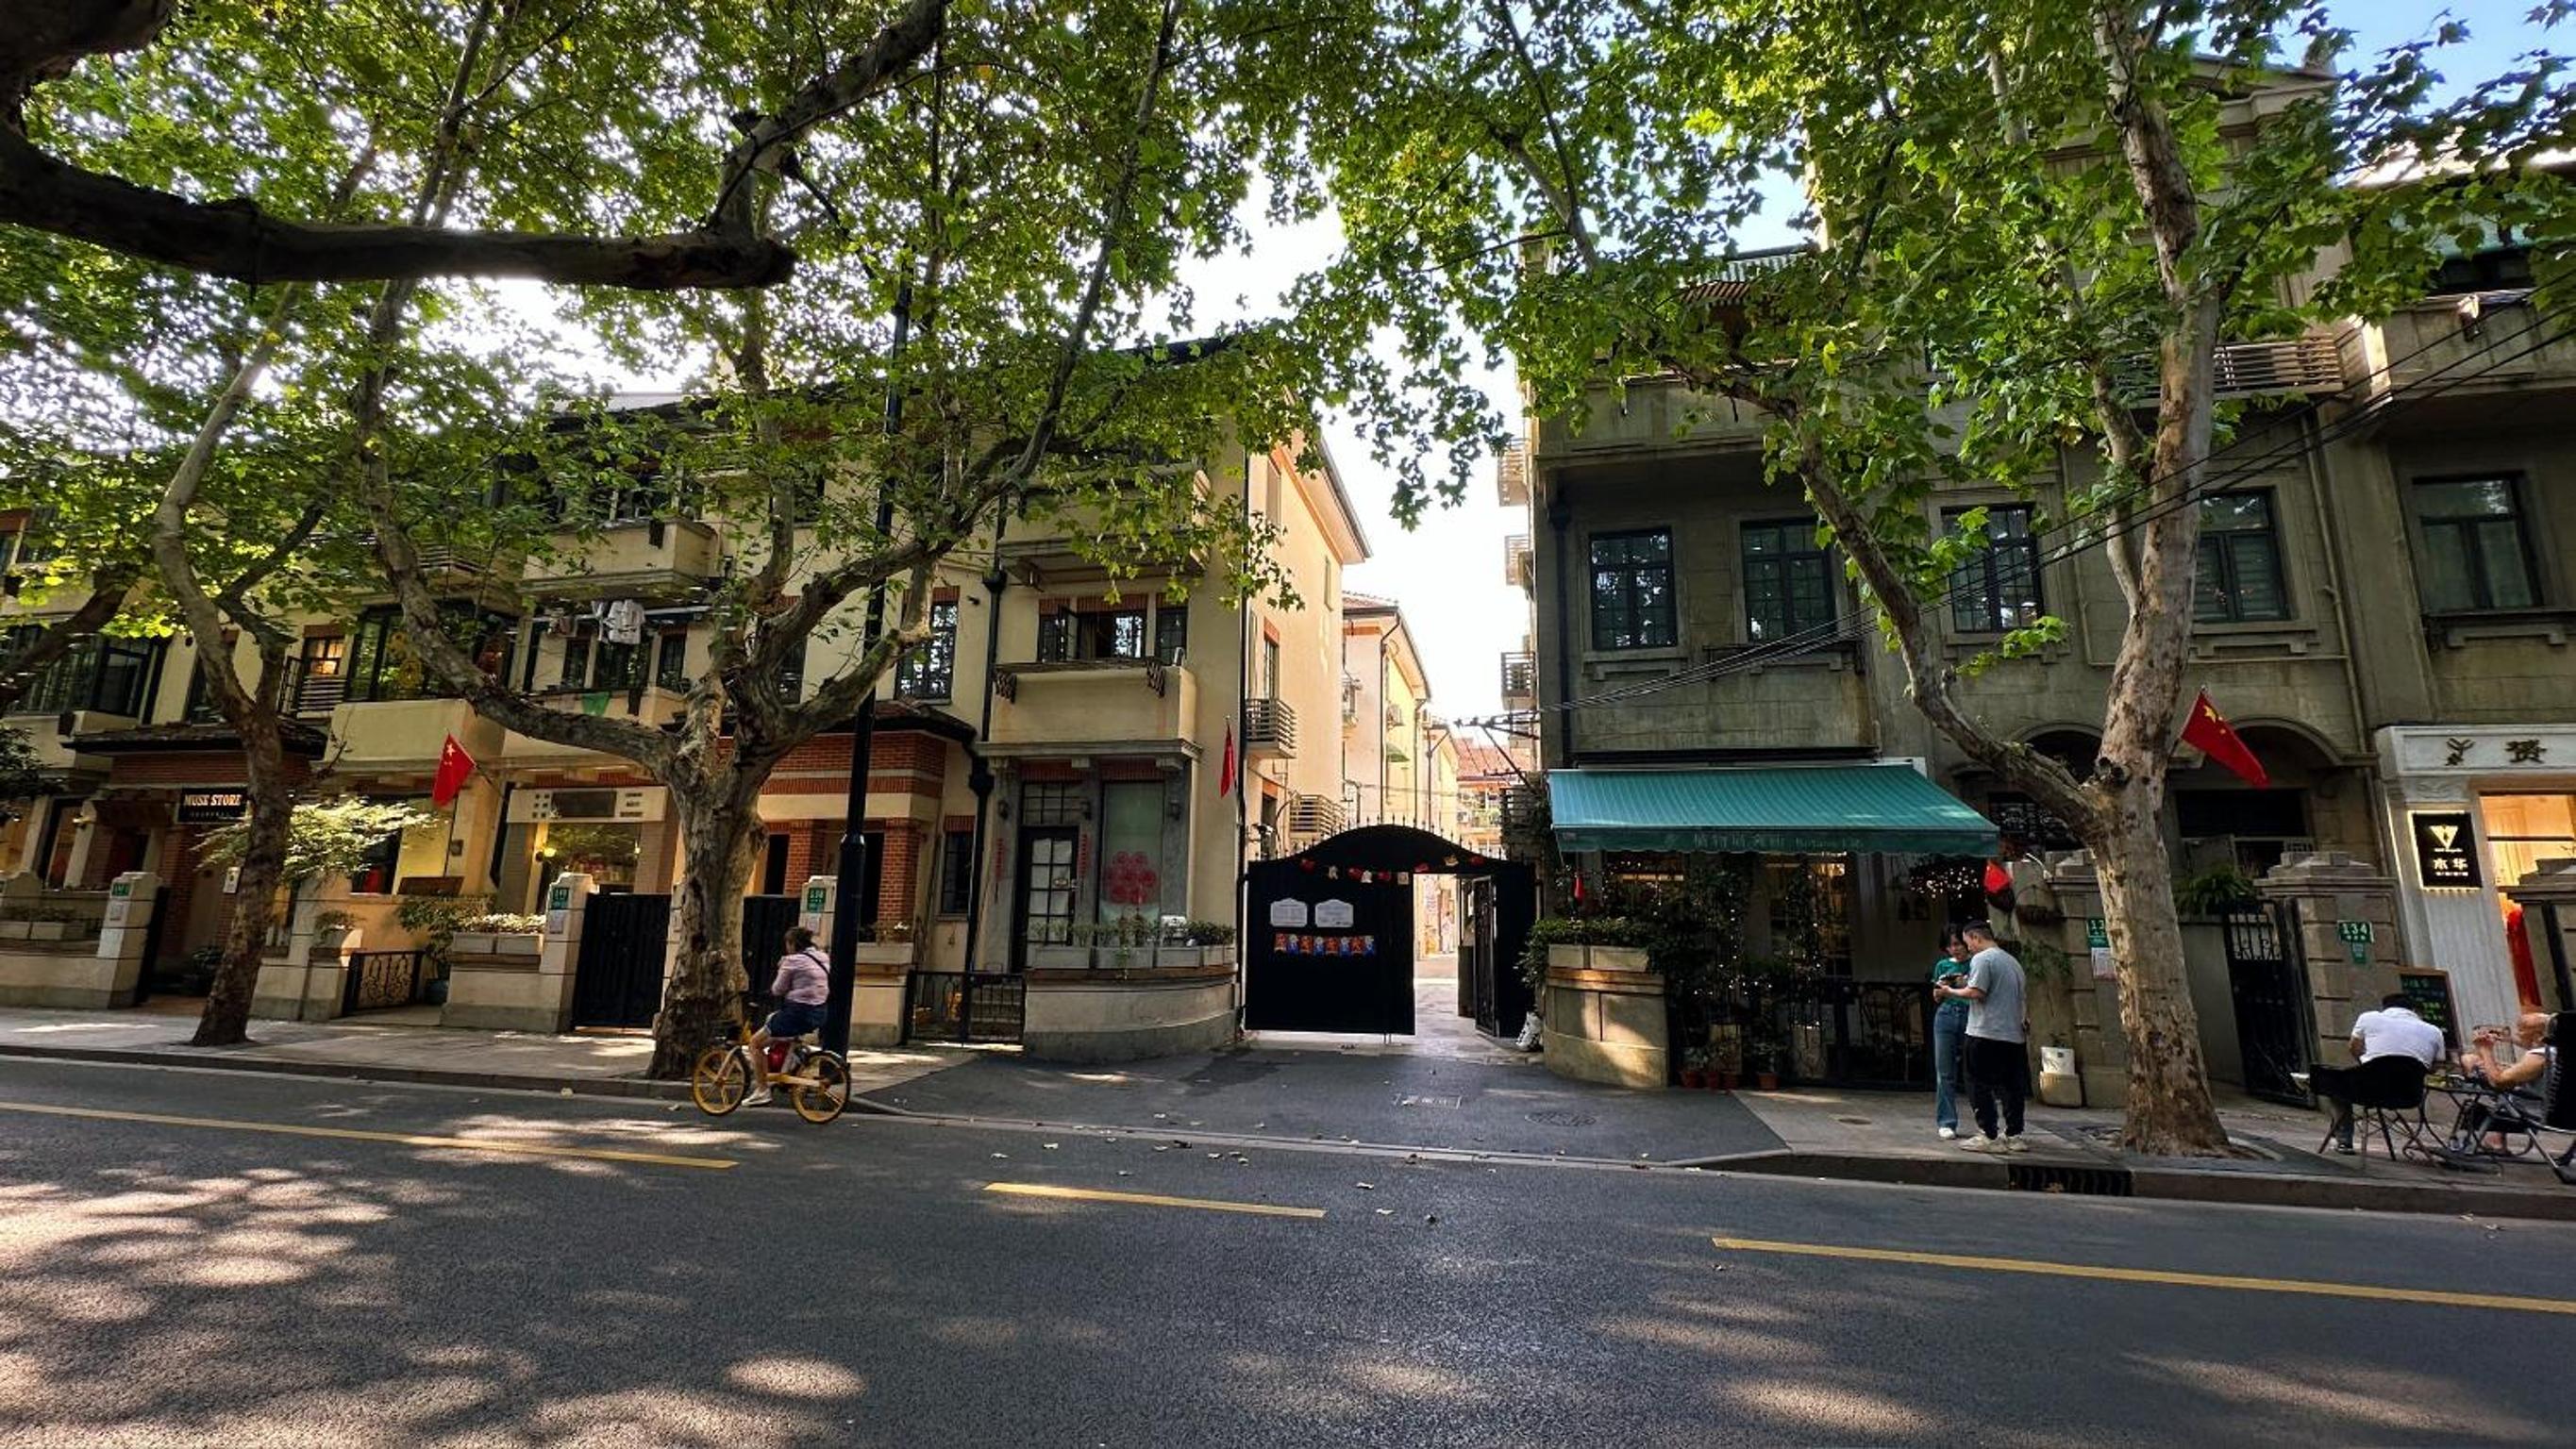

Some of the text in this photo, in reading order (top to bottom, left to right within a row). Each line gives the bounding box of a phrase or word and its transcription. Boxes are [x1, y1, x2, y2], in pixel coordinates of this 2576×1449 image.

[185, 794, 243, 806] MUSE STORE
[2342, 923, 2367, 935] 134
